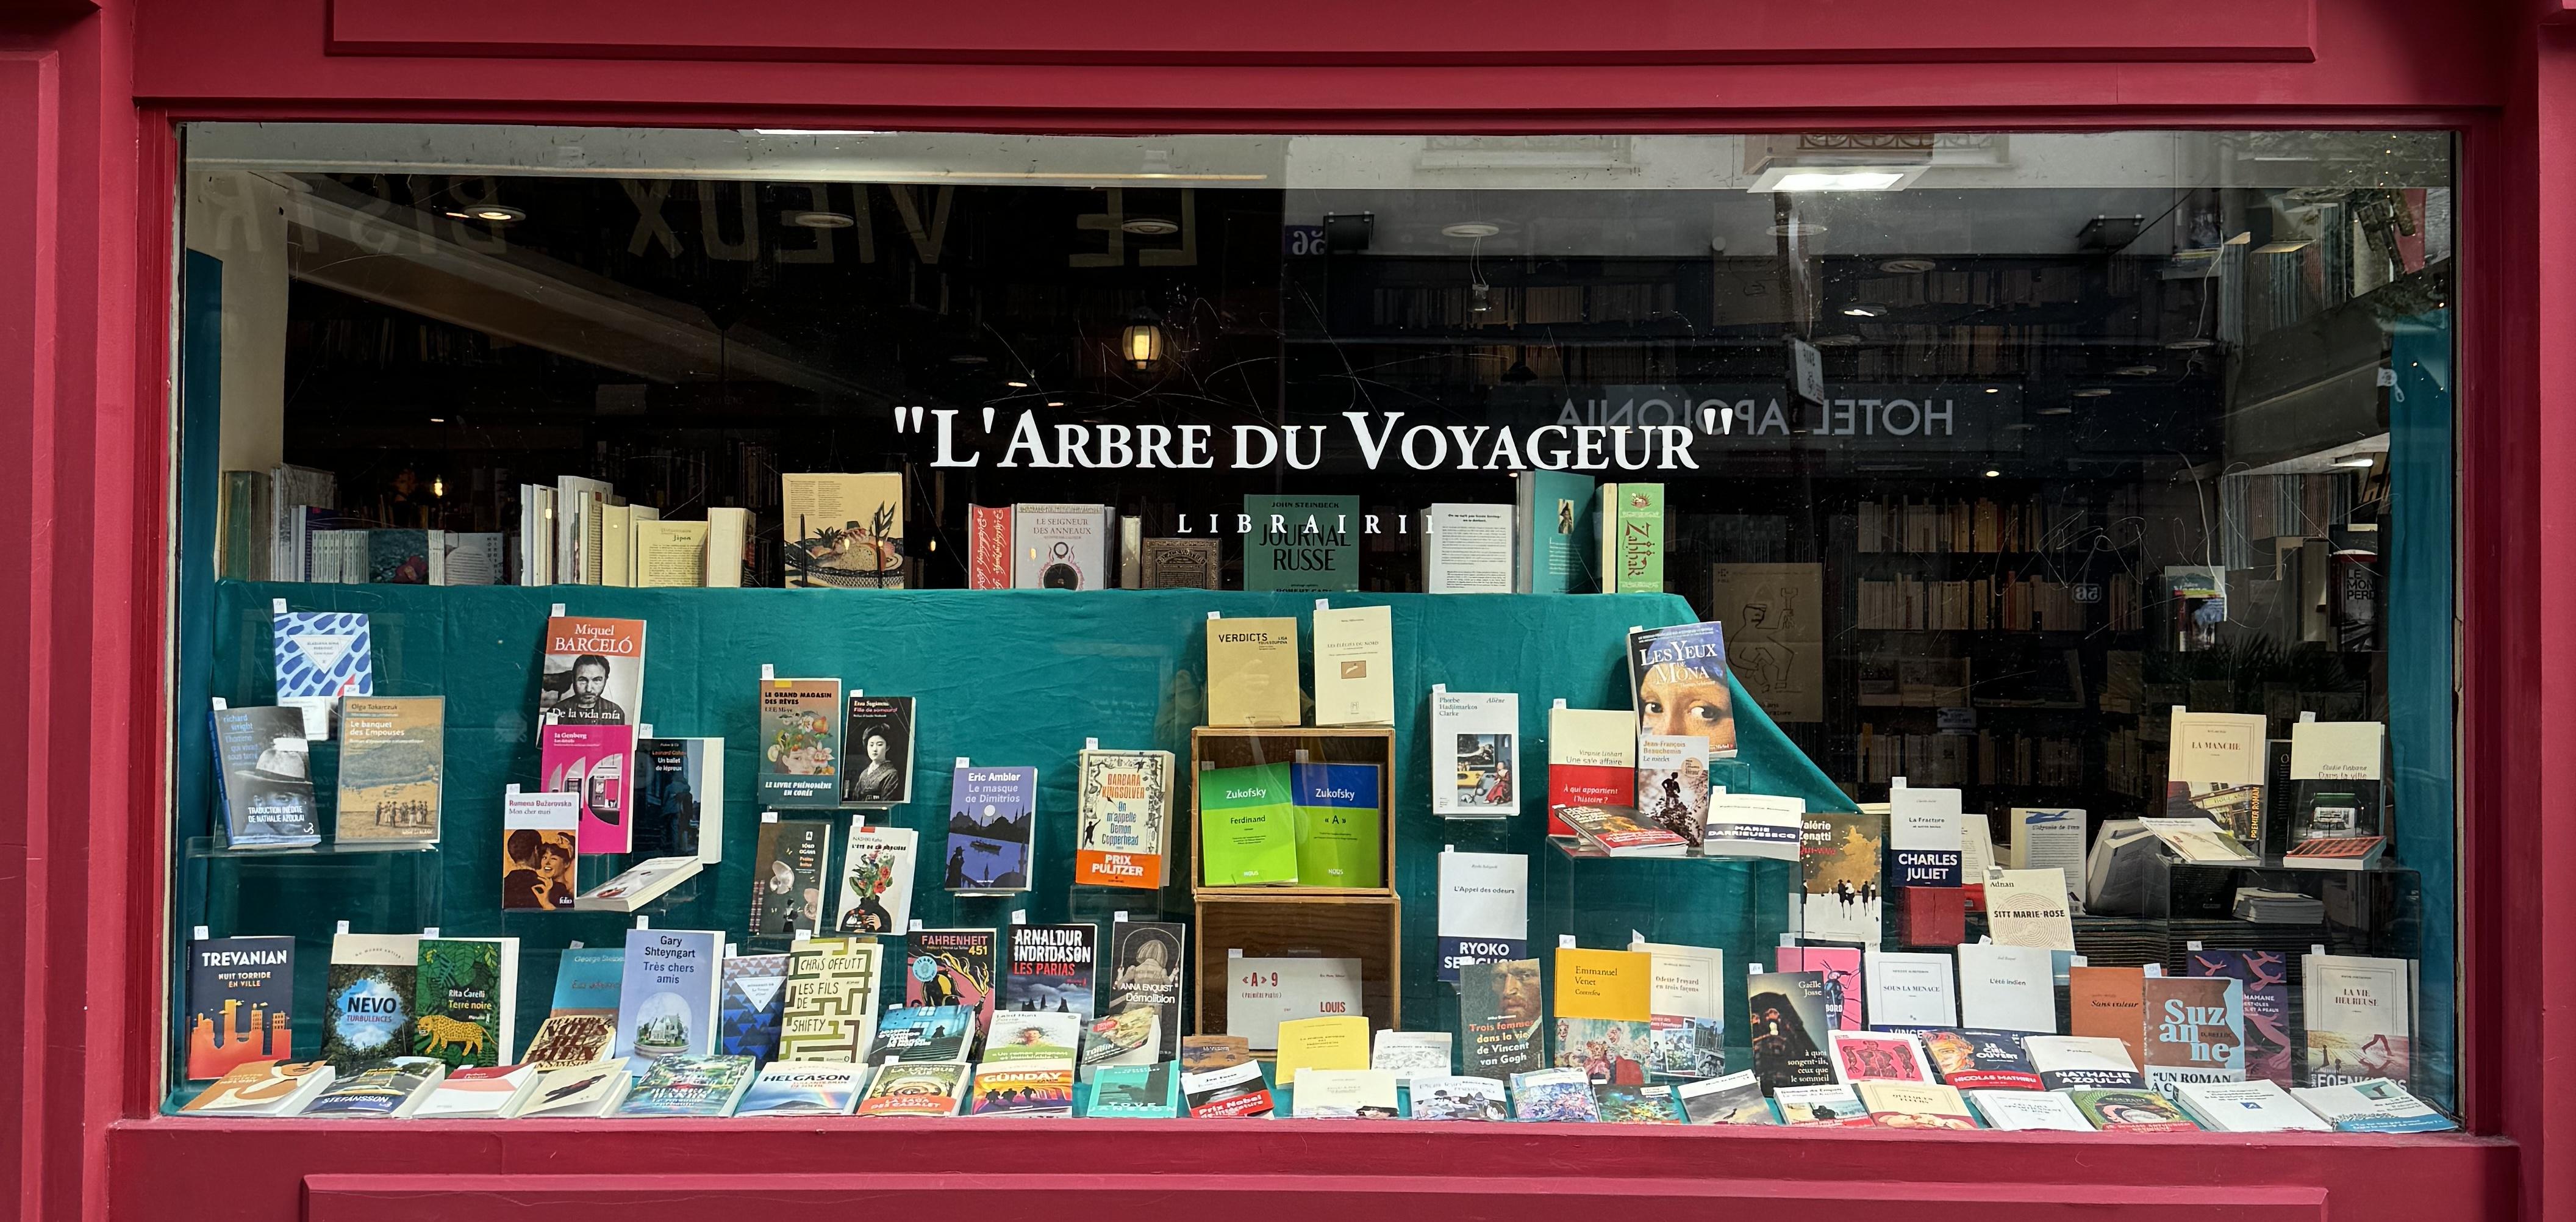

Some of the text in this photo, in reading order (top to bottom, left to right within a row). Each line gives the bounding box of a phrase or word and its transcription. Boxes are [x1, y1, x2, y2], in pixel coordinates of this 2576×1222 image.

[1232, 425, 1326, 470] DU
[1259, 523, 1351, 547] JOURNAL
[1273, 548, 1336, 571] RUSSE
[575, 624, 614, 639] Miquel
[1218, 633, 1268, 642] VERDICTS
[554, 635, 633, 653] BARCELÓ
[1639, 640, 1718, 666] LES YEUX
[1652, 663, 1709, 685] MONA
[223, 715, 248, 724] richard
[553, 708, 620, 720] De la vida mía
[231, 722, 254, 731] wright
[361, 721, 392, 730] banquet
[365, 728, 405, 737] Empouses
[2205, 742, 2241, 750] MANCHE
[1600, 757, 1622, 765] affaire
[968, 773, 1021, 782] Eric Ambler
[1107, 774, 1141, 786] BARBARA
[969, 784, 1018, 795] Le masque
[1102, 785, 1145, 799] KINGSOLVER
[1226, 788, 1267, 799] Zukofsky
[1315, 788, 1355, 801] Zukofsky
[979, 794, 1020, 803] Dimitrios
[1118, 801, 1127, 812] On
[1106, 811, 1137, 824] m'appelle
[1230, 814, 1265, 824] Ferdinand
[1110, 822, 1132, 835] Demon
[1101, 833, 1139, 848] Copperhead
[1104, 854, 1131, 866] PRIX
[1898, 854, 1958, 866] CHARLES
[1092, 863, 1144, 877] PULITZER
[1906, 868, 1949, 882] JULIET
[1994, 909, 2066, 918] SITT MARIE-ROSE
[660, 935, 682, 947] Gary
[921, 935, 988, 946] FAHRENHEIT
[1015, 929, 1082, 946] ARNALDUR
[645, 946, 695, 959] Shteyngart
[968, 945, 988, 955] 451
[1014, 946, 1091, 963] INDRIDASON
[1459, 942, 1510, 956] RYOKO
[202, 950, 287, 967] TREVANIAN
[800, 957, 864, 971] CHRIS OFFUTT
[643, 961, 694, 972] Très chers
[1014, 962, 1075, 976] LES PARIAS
[1575, 966, 1618, 977] Emmanuel
[657, 974, 680, 984] amis
[1575, 976, 1596, 986] Venet
[1798, 980, 1822, 989] Gaëlle
[798, 979, 839, 996] LES FILS
[1120, 983, 1141, 991] ANNA
[1804, 988, 1822, 997] Josse
[448, 988, 485, 999] Rita Carelli
[1125, 993, 1176, 1004] Démolition
[347, 997, 396, 1013] NEVO
[797, 997, 807, 1009] DE
[1320, 1001, 1346, 1013] LOUIS
[2335, 997, 2378, 1006] HEUREUSE
[2164, 999, 2226, 1026] Suz
[792, 1016, 826, 1032] SHIFTY
[1469, 1020, 1534, 1032] Trois femmes
[1476, 1032, 1529, 1043] dans la vie
[2158, 1023, 2201, 1043] an
[1476, 1042, 1530, 1055] de Vincent
[2190, 1042, 2230, 1062] ne
[1479, 1052, 1527, 1066] van Gogh
[1787, 1058, 1829, 1068] songent-ils,
[763, 1074, 851, 1083] HELGASON
[983, 1072, 1064, 1083] GÜNDAY
[2062, 1076, 2132, 1085] AZOULAI
[2181, 1072, 2231, 1084] ROMAN
[321, 1094, 389, 1104] STEFÁNSSON
[1198, 1094, 1262, 1115] Prix Nobel
